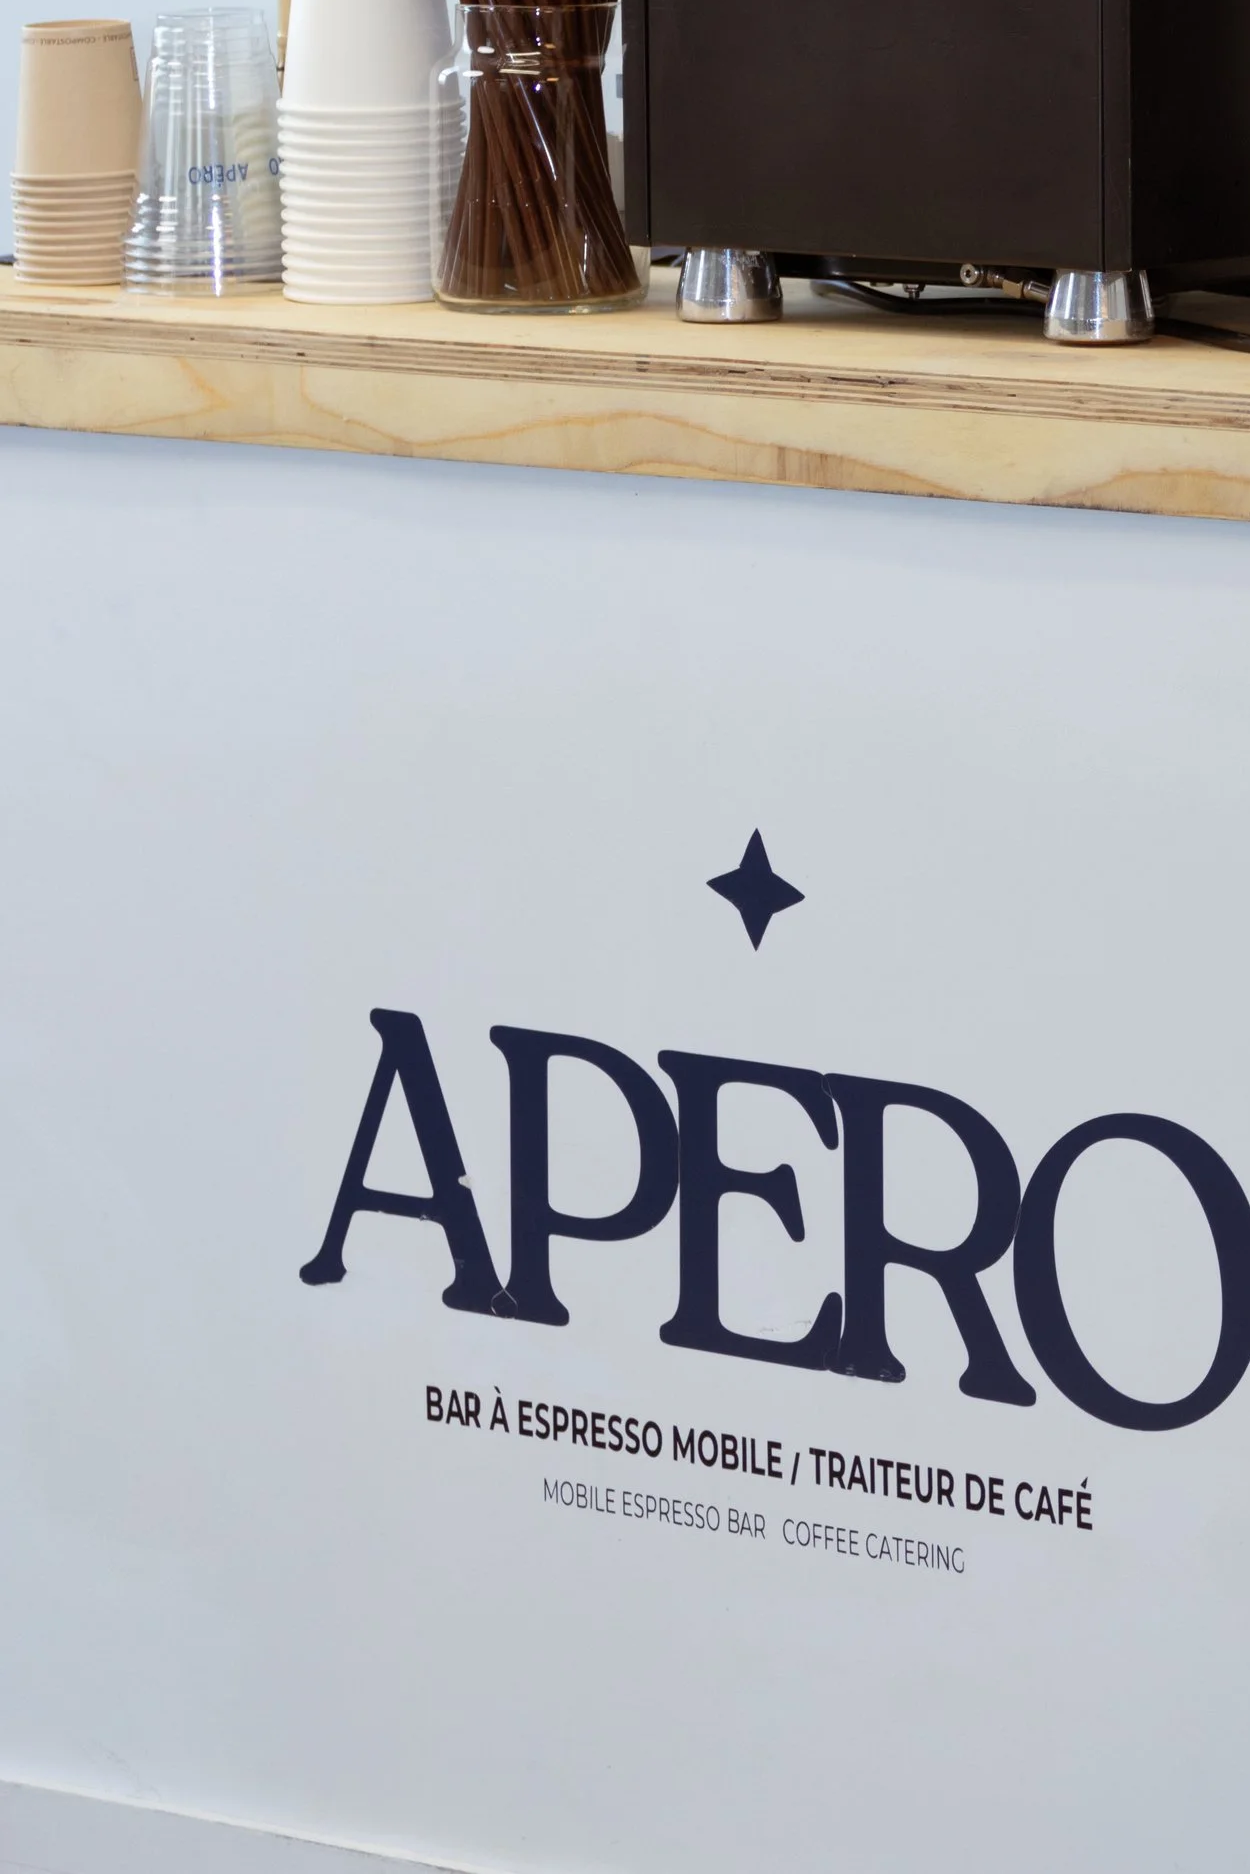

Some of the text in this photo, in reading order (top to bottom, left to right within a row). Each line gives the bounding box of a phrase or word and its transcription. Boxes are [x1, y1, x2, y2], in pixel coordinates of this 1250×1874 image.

[426, 1385, 481, 1429] BAR
[489, 1385, 510, 1434] À
[518, 1399, 663, 1459] ESPRESSO
[672, 1424, 783, 1480] MOBILE
[808, 1446, 955, 1508] TRAITEUR
[965, 1472, 1006, 1517] DE
[1014, 1476, 1093, 1531] CAFÉ
[543, 1477, 766, 1540] MOBILE ESPRESSO BAR
[782, 1518, 965, 1574] COFFEE CATERING
